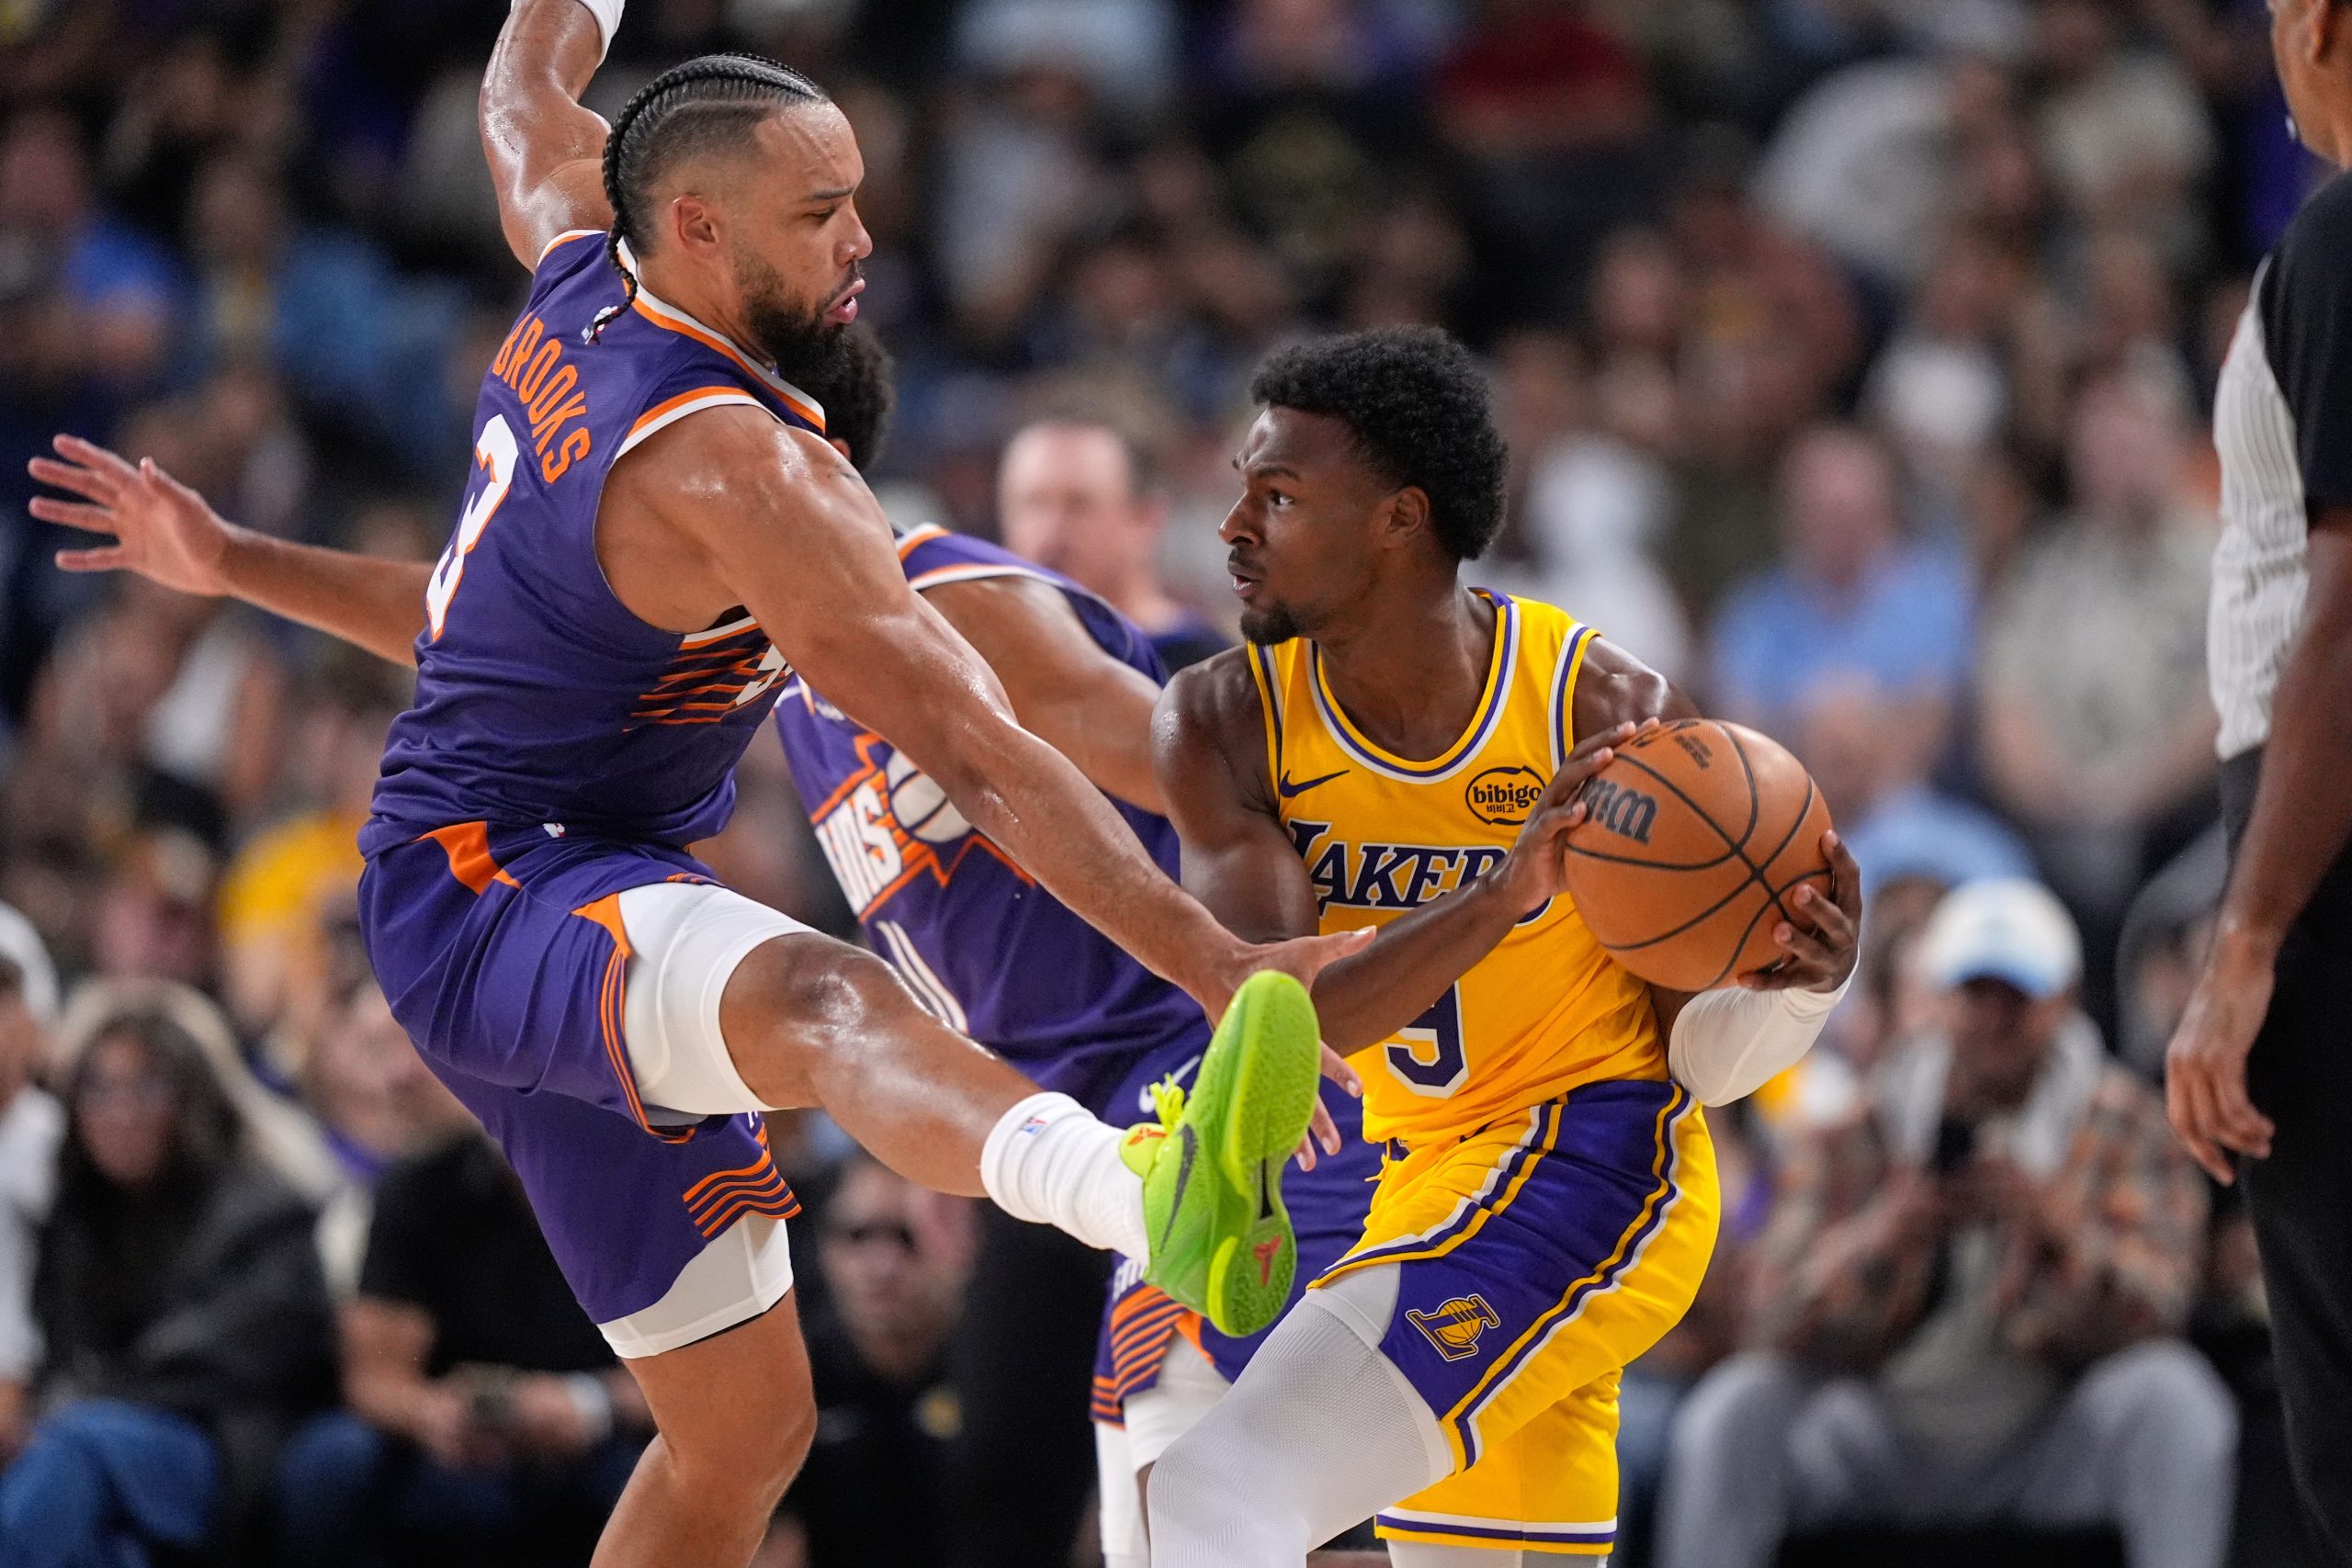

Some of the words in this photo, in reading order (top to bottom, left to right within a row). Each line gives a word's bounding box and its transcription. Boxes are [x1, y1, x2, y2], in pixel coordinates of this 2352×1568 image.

[492, 311, 592, 483] BROOKS
[425, 412, 520, 643] 3
[1473, 783, 1543, 808] bibigo
[1486, 803, 1516, 814] 비비고
[1285, 817, 1553, 927] LAKER
